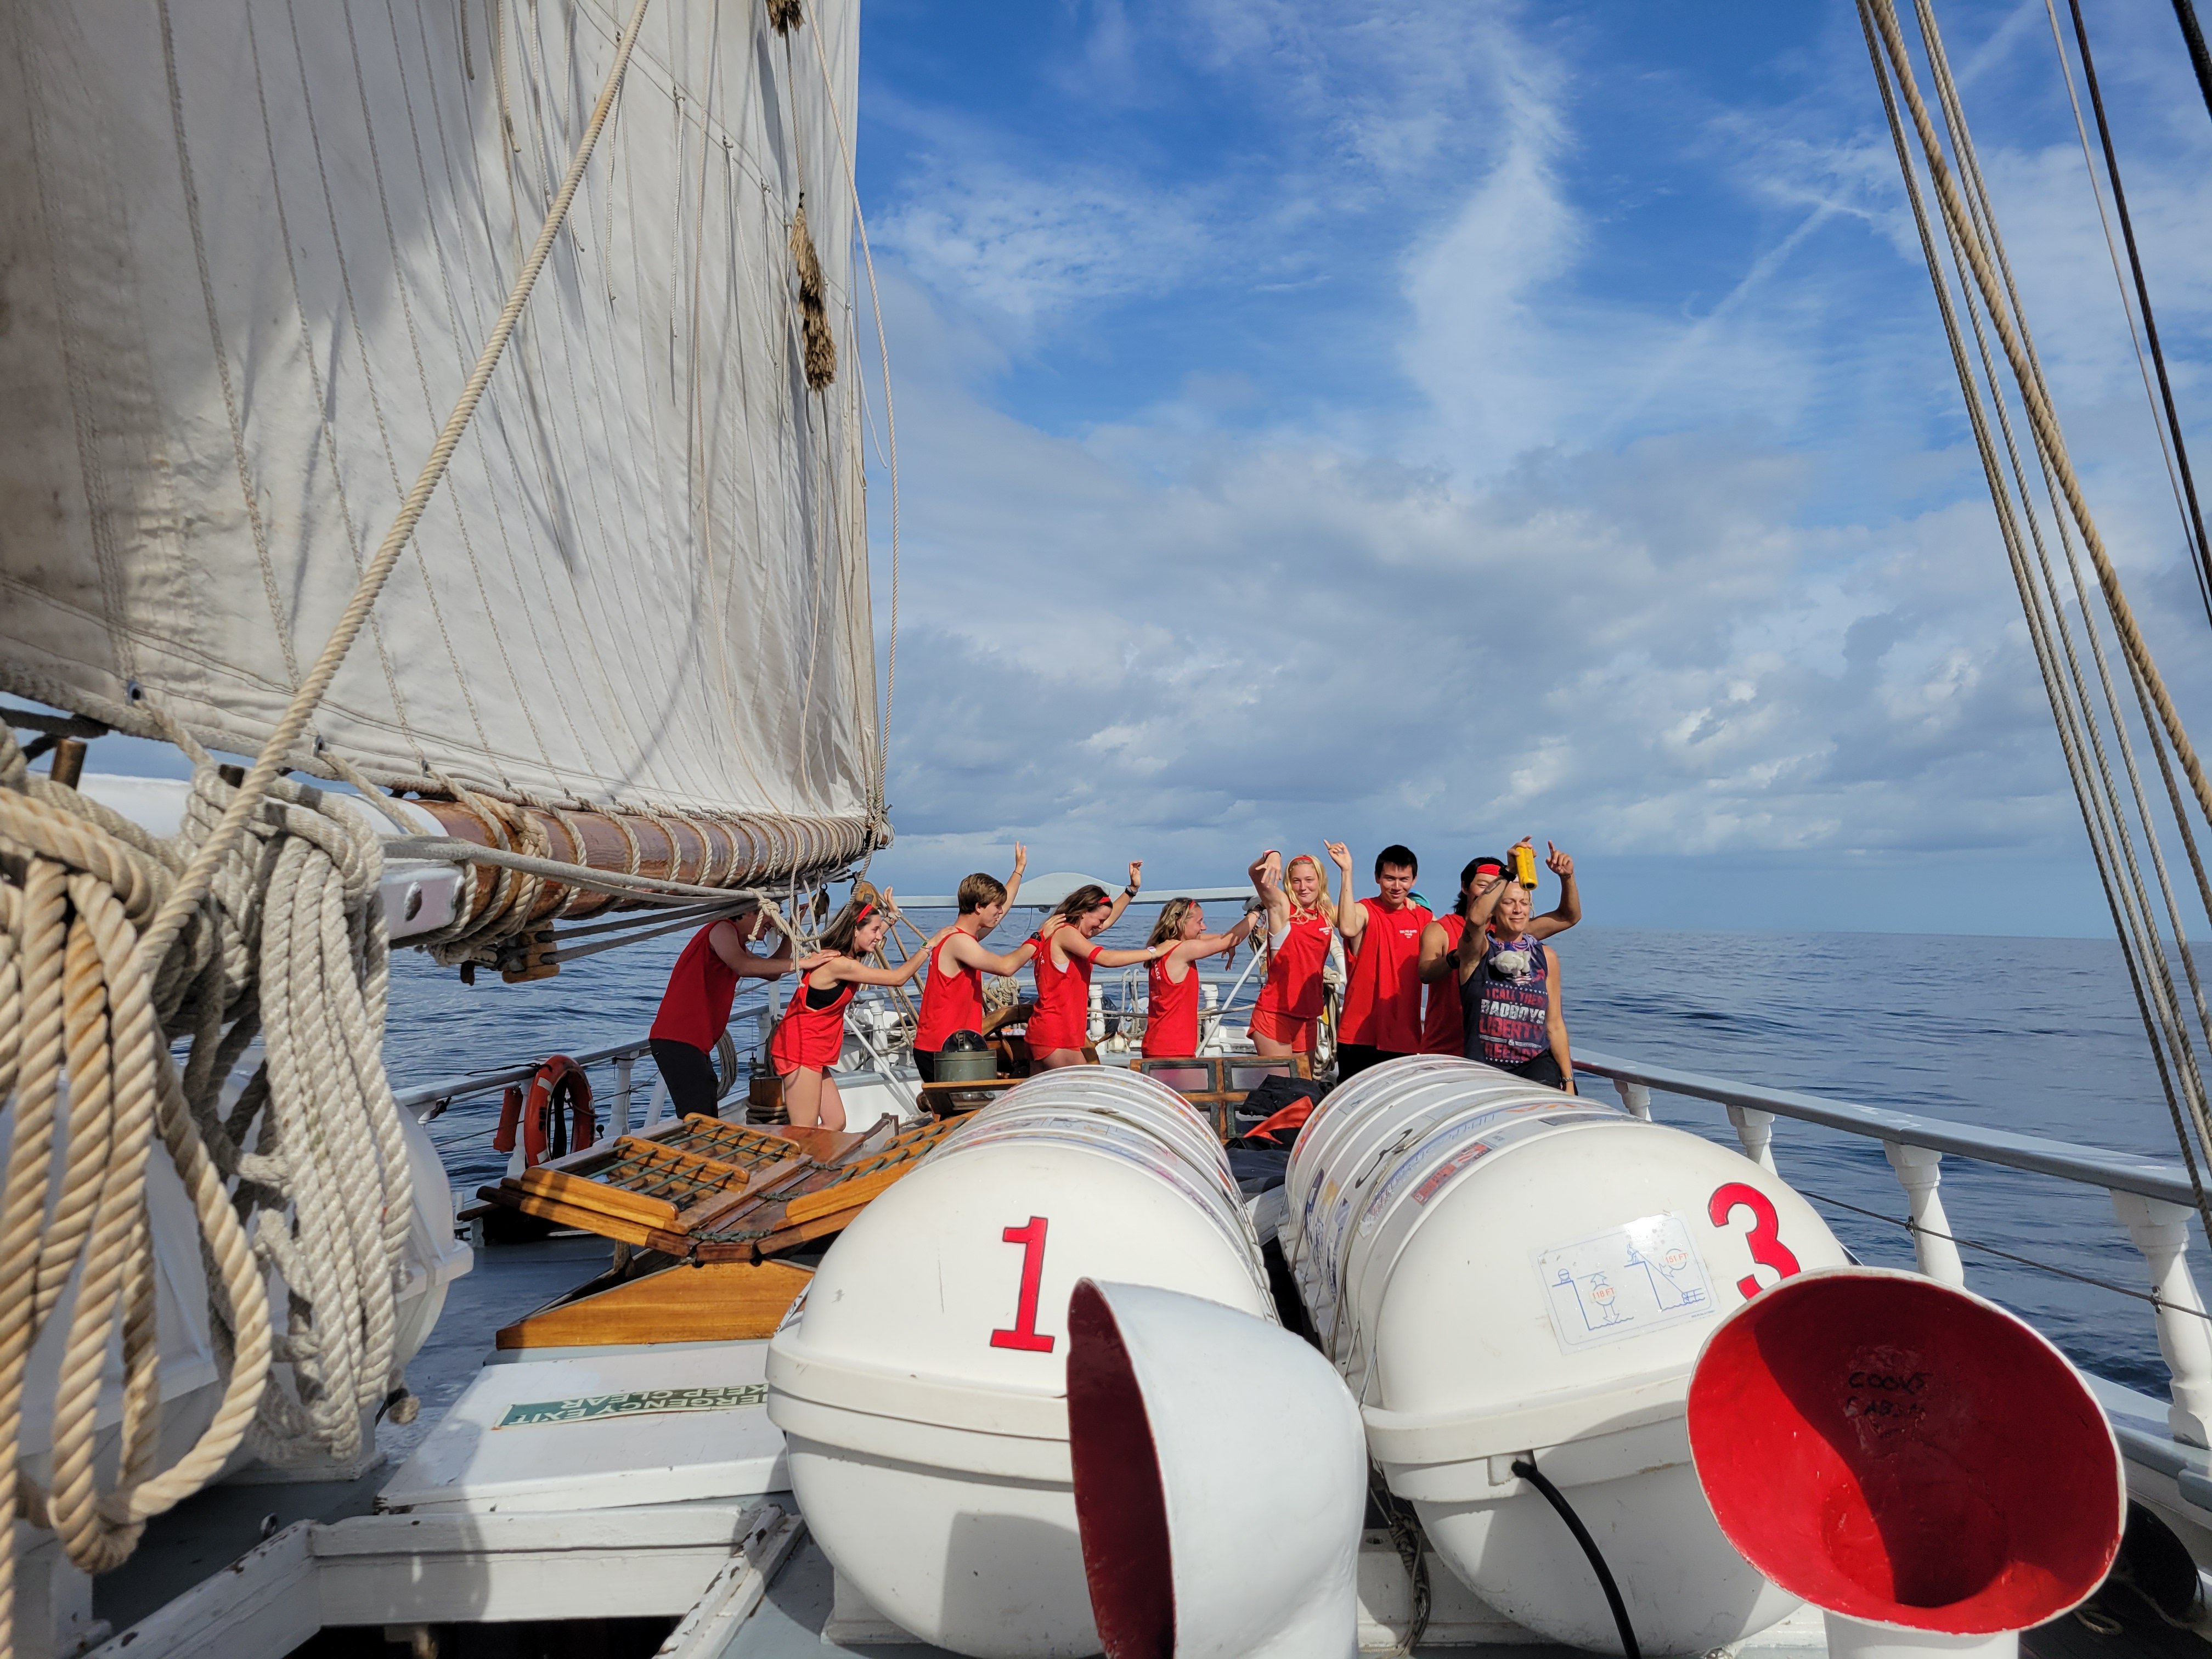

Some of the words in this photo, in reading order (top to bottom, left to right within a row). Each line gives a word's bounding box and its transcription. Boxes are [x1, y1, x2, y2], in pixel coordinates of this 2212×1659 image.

[1486, 988, 1489, 998] I
[1492, 988, 1515, 1001] CALL
[1480, 998, 1545, 1024] BADBOYS
[1479, 1015, 1543, 1040] LIBERTY
[1708, 1182, 1801, 1301] 3
[1665, 1255, 1679, 1263] 151
[1679, 1252, 1688, 1261] FT
[990, 1215, 1055, 1353] 1
[1592, 1290, 1605, 1300] 118
[1605, 1287, 1615, 1296] FT
[561, 1391, 675, 1409] CLEAR
[684, 1384, 768, 1398] KEEP
[597, 1393, 768, 1415] ERGENCY
[509, 1408, 586, 1425] EXIT
